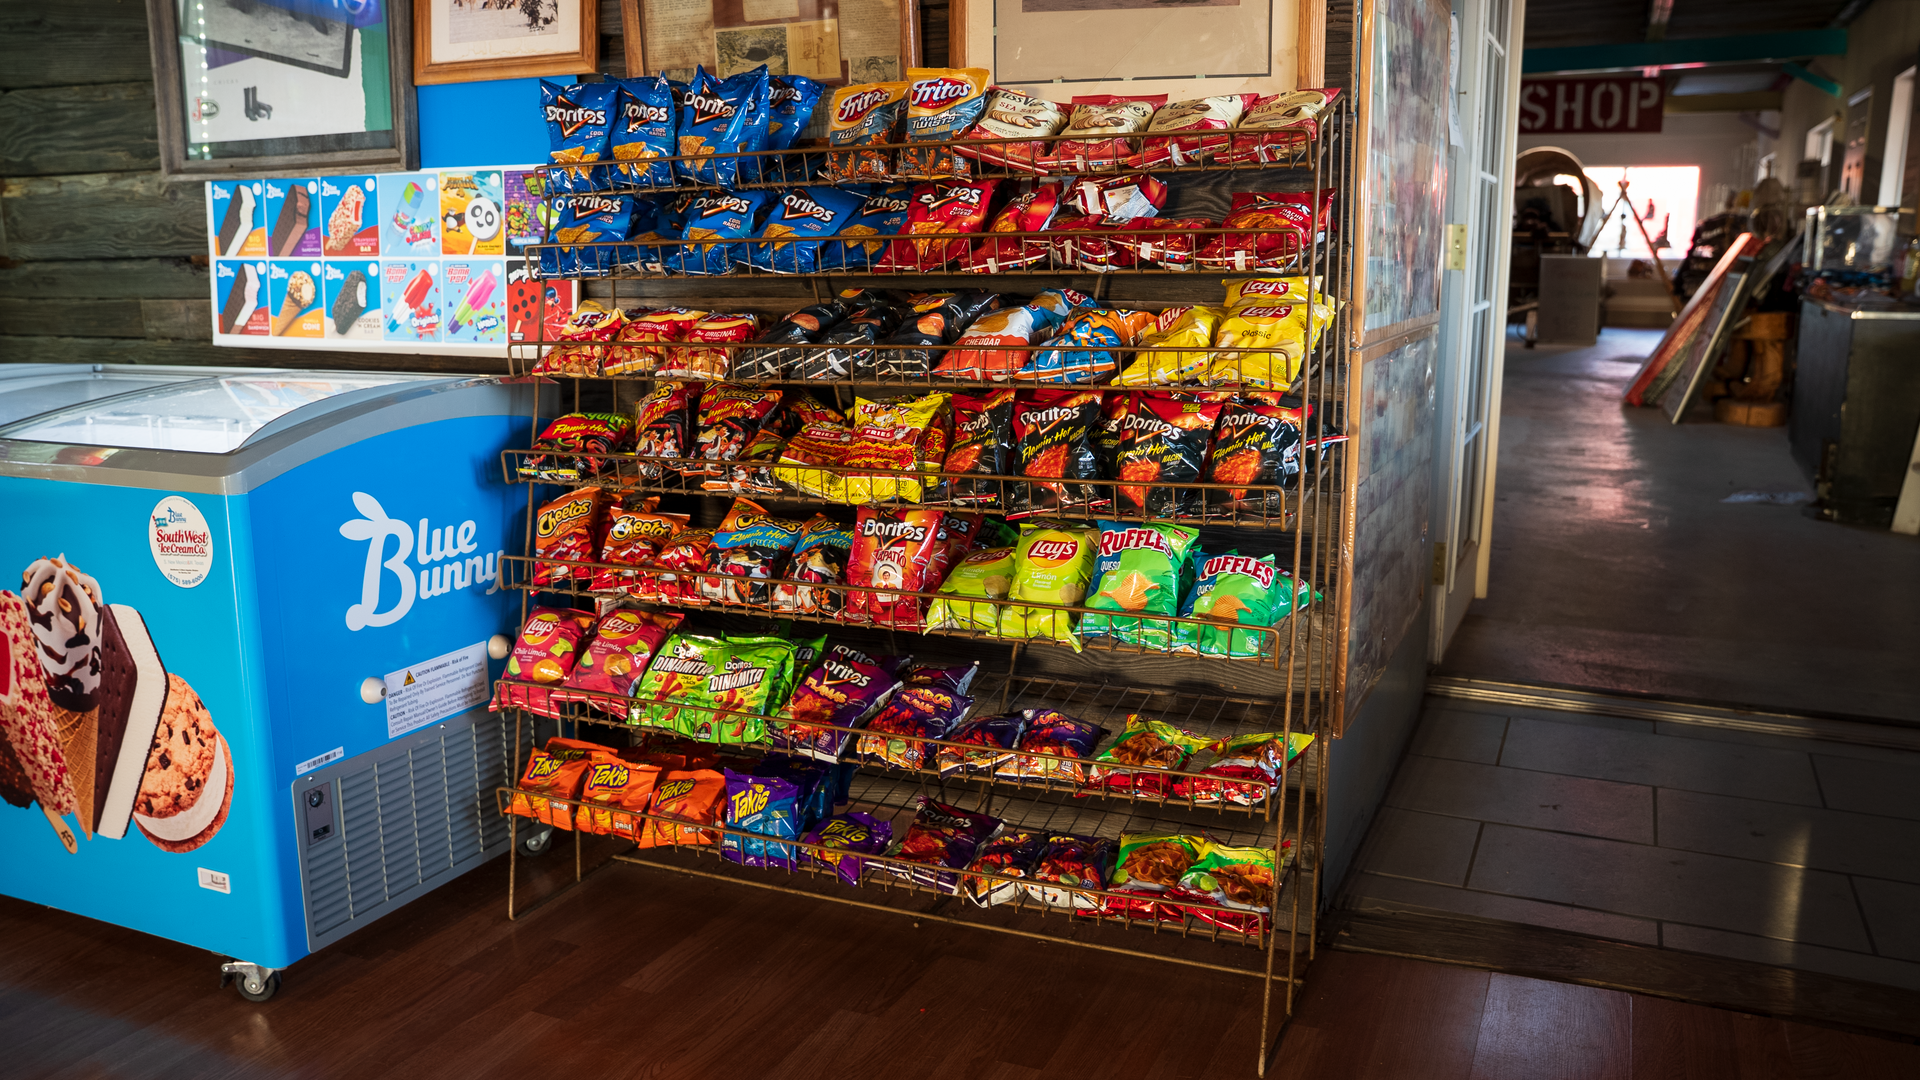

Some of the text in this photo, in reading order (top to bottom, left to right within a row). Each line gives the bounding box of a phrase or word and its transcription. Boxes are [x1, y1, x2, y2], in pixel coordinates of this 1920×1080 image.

[911, 78, 971, 106] Fritos
[684, 91, 738, 118] Doritos
[838, 90, 889, 122] Fritos
[999, 101, 1017, 112] SEA
[1255, 105, 1272, 114] SEA
[1520, 81, 1660, 130] SHOP
[546, 105, 607, 125] Doritos
[911, 115, 956, 129] TWISTS
[952, 207, 973, 215] NACHO
[1245, 280, 1289, 295] Lay's
[1242, 305, 1291, 319] Lay's
[302, 323, 321, 331] CONE
[637, 322, 669, 331] ORIGINAL
[964, 338, 1001, 346] CHEDDAR
[1241, 329, 1272, 340] Classic
[1020, 406, 1080, 425] Doritos
[1221, 411, 1279, 430] Doritos
[552, 423, 611, 436] Flamin' Hot
[810, 430, 835, 438] FRIES
[867, 429, 891, 438] FRIES
[1124, 413, 1182, 440] Doritos
[1022, 425, 1075, 464] Flamin' Hot
[1148, 442, 1170, 455] Hot
[1213, 431, 1267, 461] Flamin' Hot
[1161, 451, 1183, 463] NACHO
[538, 500, 593, 537] Cheetos
[156, 528, 207, 544] South West
[765, 529, 787, 540] Hot
[863, 518, 926, 541] Doritos
[160, 543, 170, 554] Ice
[170, 543, 194, 554] Cream
[750, 538, 781, 550] Puffs
[1030, 539, 1078, 561] Lay's
[1098, 527, 1173, 560] RUFFLES
[1100, 561, 1121, 571] QUESO
[1031, 571, 1057, 581] Limón
[525, 618, 560, 638] Lay's
[603, 616, 639, 633] Lay's
[514, 647, 547, 658] Chile Limón
[602, 641, 622, 653] Limón
[430, 662, 449, 671] FLAMMABLE
[709, 667, 767, 694] DINAMITA
[590, 763, 629, 788] Takis
[655, 779, 695, 806] Takis
[731, 788, 771, 825] Takis
[819, 819, 870, 842] Takis
